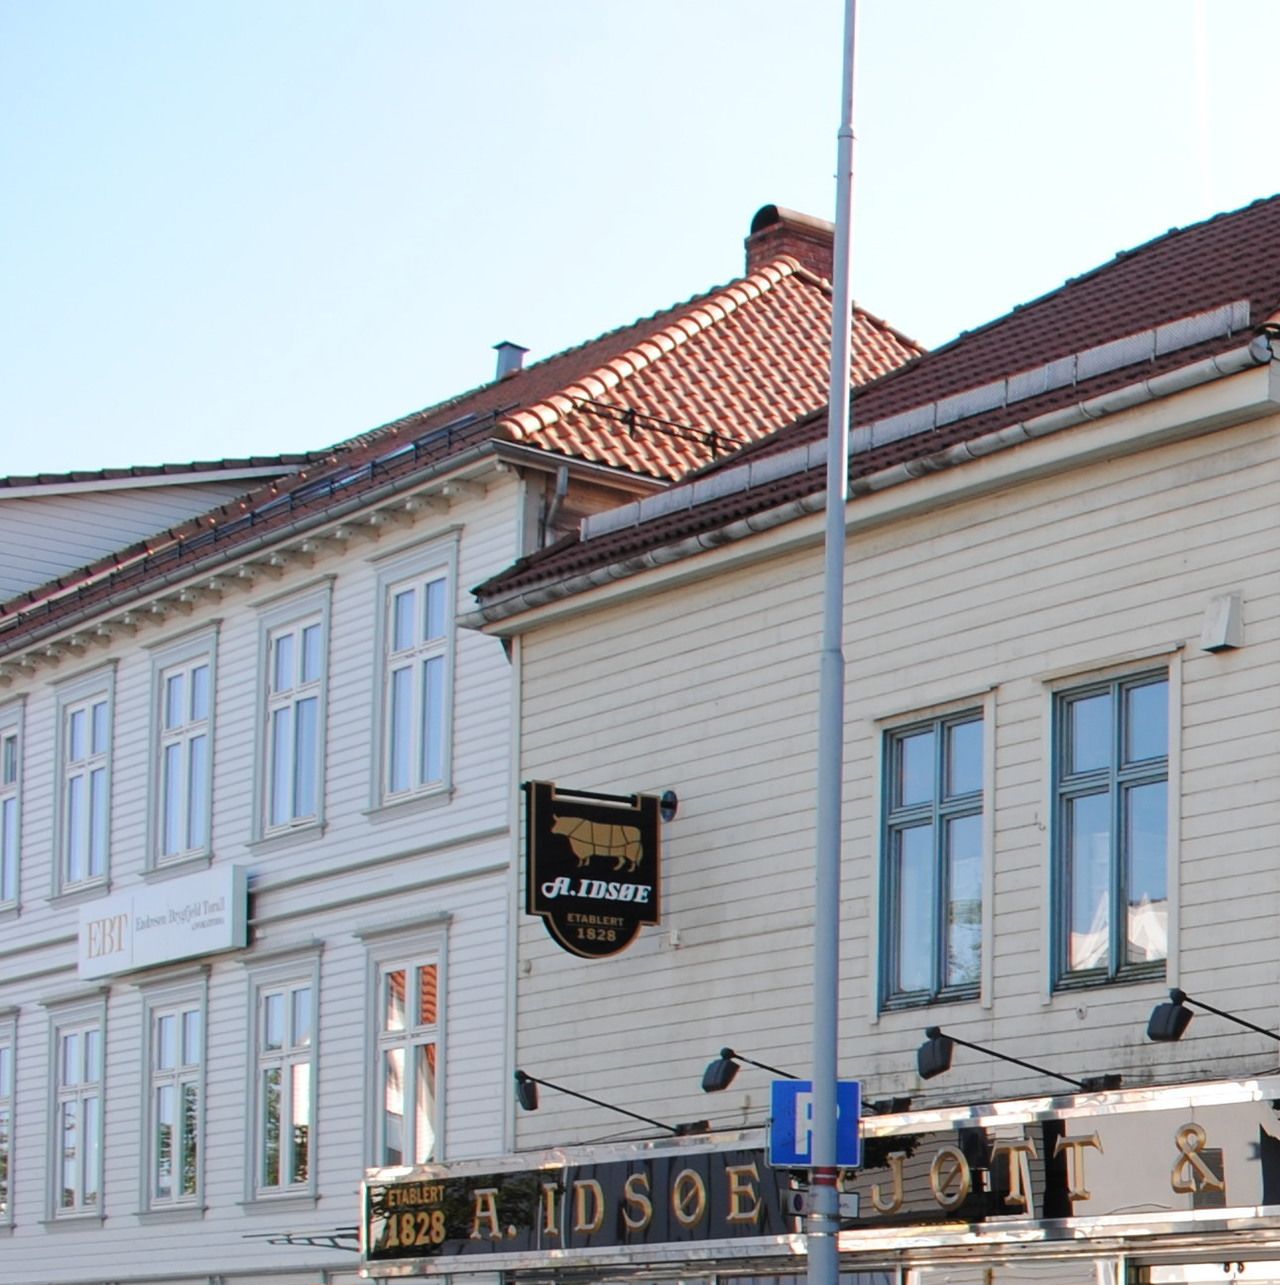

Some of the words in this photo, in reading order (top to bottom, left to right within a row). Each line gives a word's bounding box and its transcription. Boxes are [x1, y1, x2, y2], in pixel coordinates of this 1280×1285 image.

[567, 912, 625, 927] ETABLERT
[577, 927, 617, 942] 1828
[86, 913, 128, 959] EBT
[388, 1184, 446, 1208] ETABLERT
[469, 1187, 518, 1240] A.
[542, 1160, 763, 1235] IDSØE
[836, 1129, 1104, 1215] JØTT
[1170, 1122, 1225, 1194] &
[385, 1211, 447, 1249] 1828
